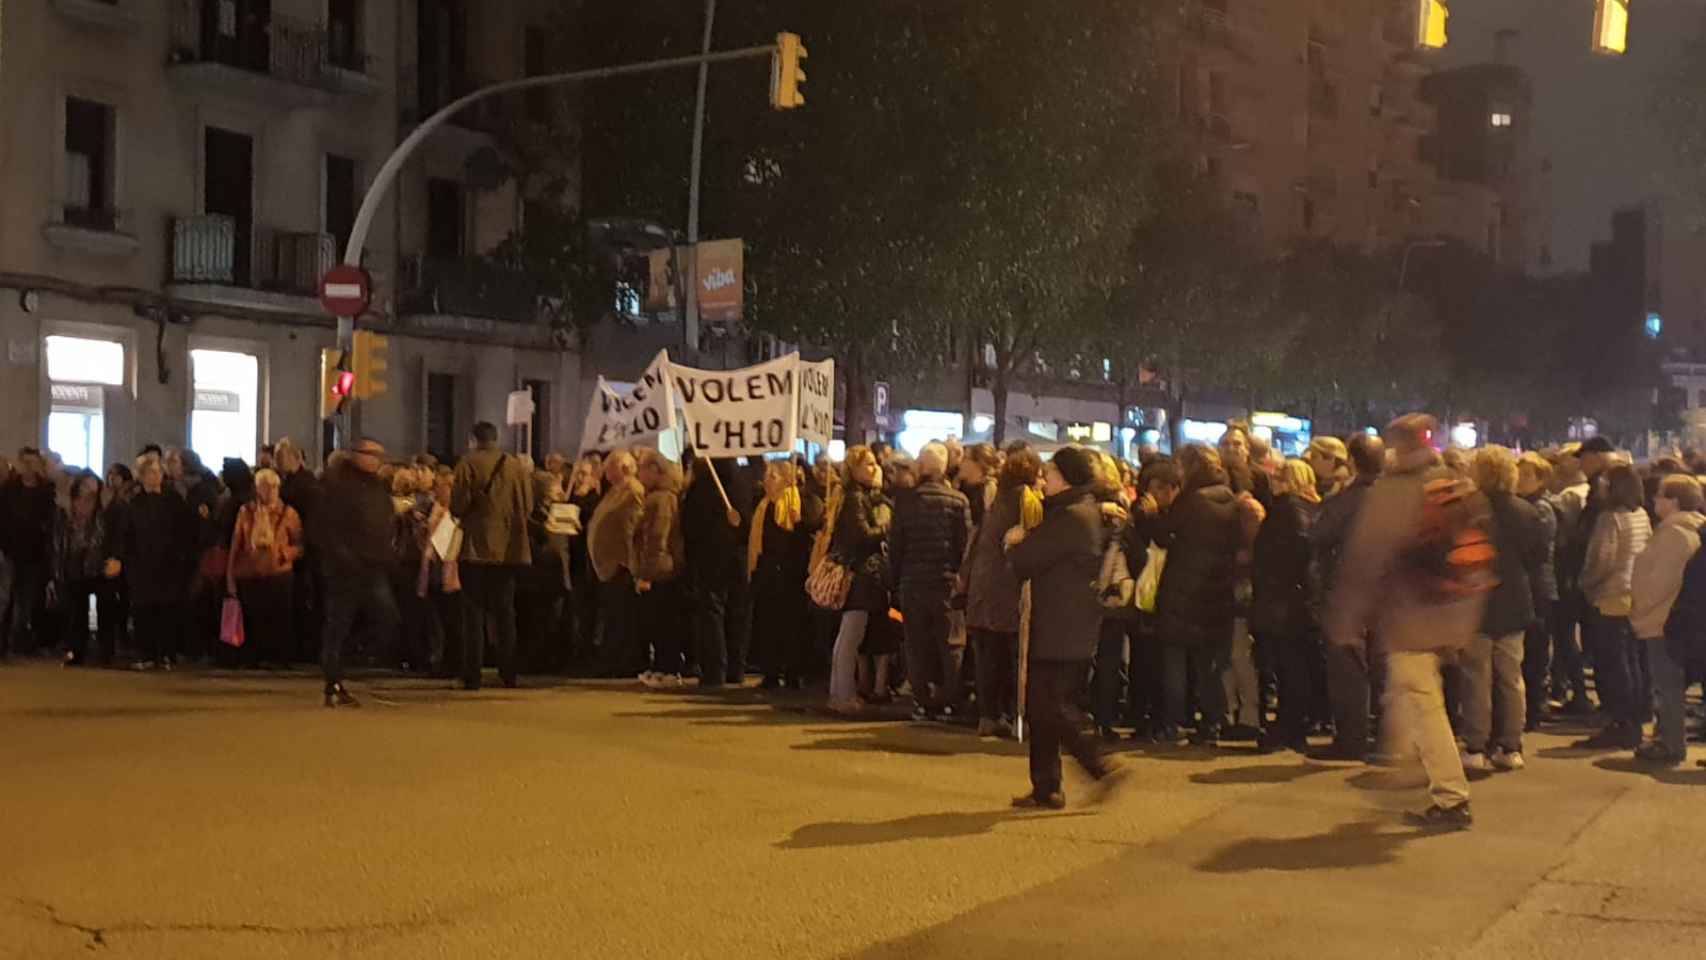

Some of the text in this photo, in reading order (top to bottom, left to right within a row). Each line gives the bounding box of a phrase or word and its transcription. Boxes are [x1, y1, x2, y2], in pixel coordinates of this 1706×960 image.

[676, 370, 793, 403] VOLEM
[877, 386, 887, 415] P
[695, 419, 784, 449] L'H10
